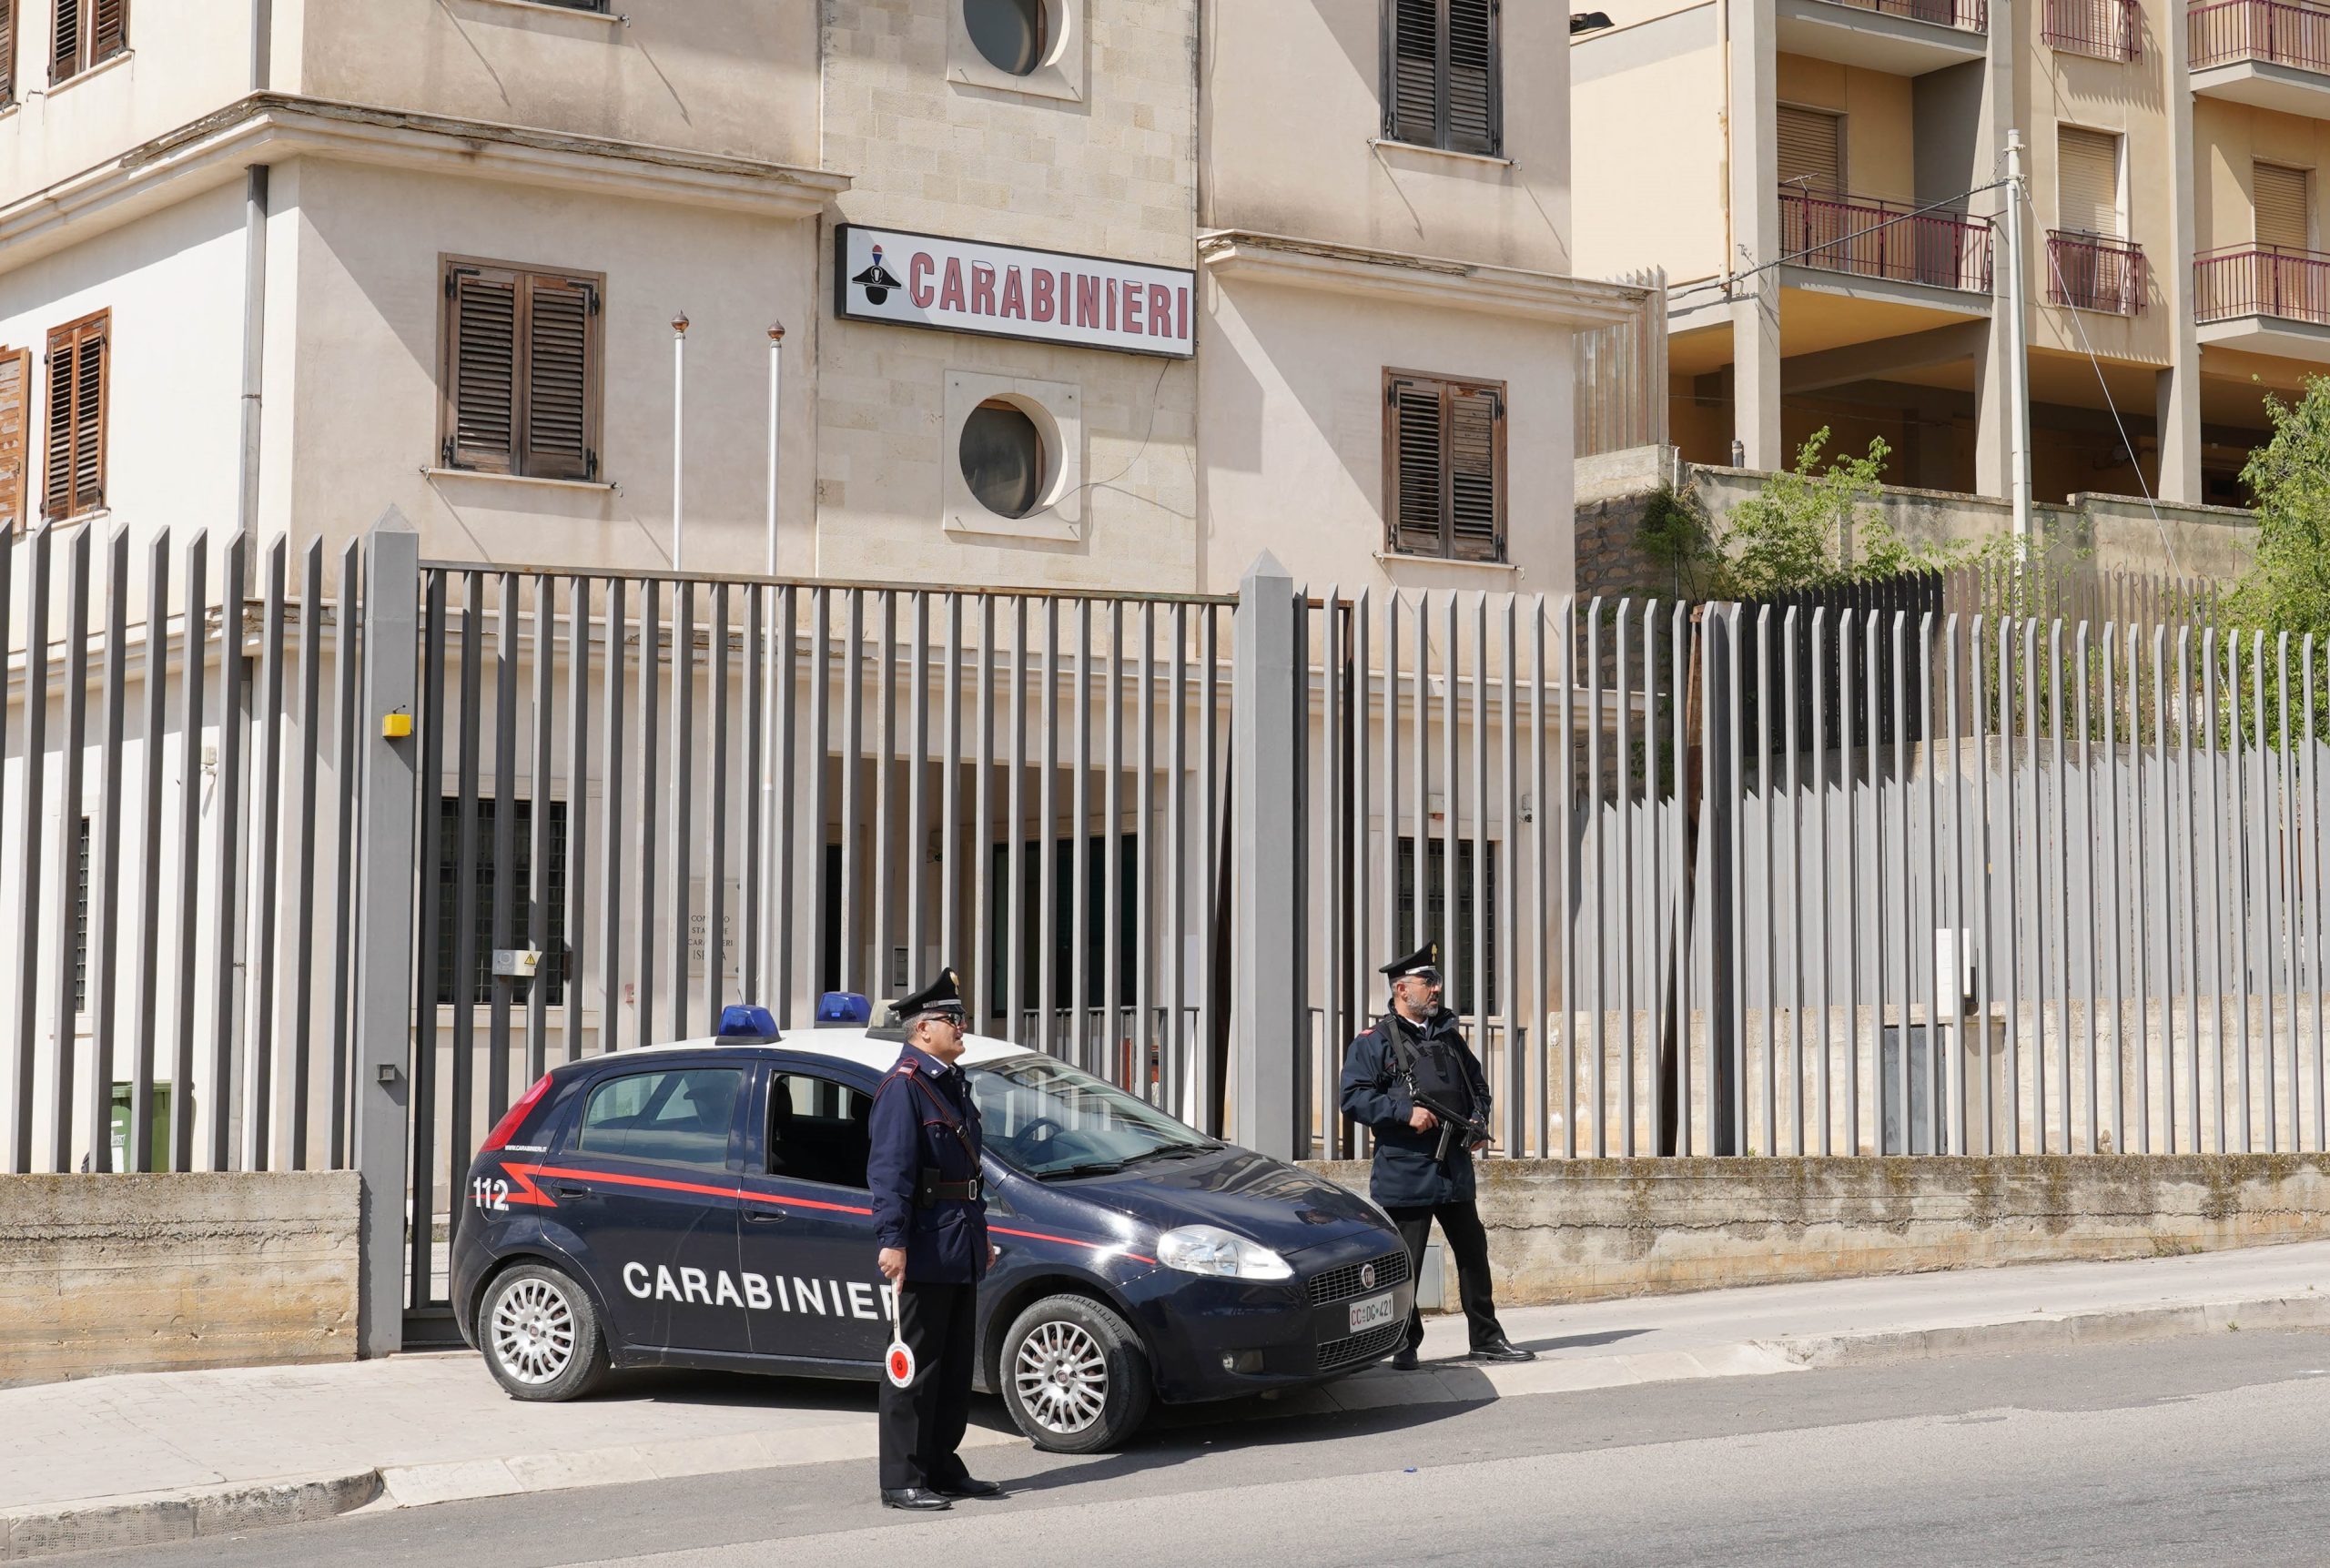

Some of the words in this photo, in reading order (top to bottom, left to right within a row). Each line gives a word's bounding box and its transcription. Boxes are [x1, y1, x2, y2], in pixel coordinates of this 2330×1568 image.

[910, 252, 1188, 339] CARABINIERI
[473, 1176, 510, 1211] 112
[623, 1261, 893, 1321] CARABINIE
